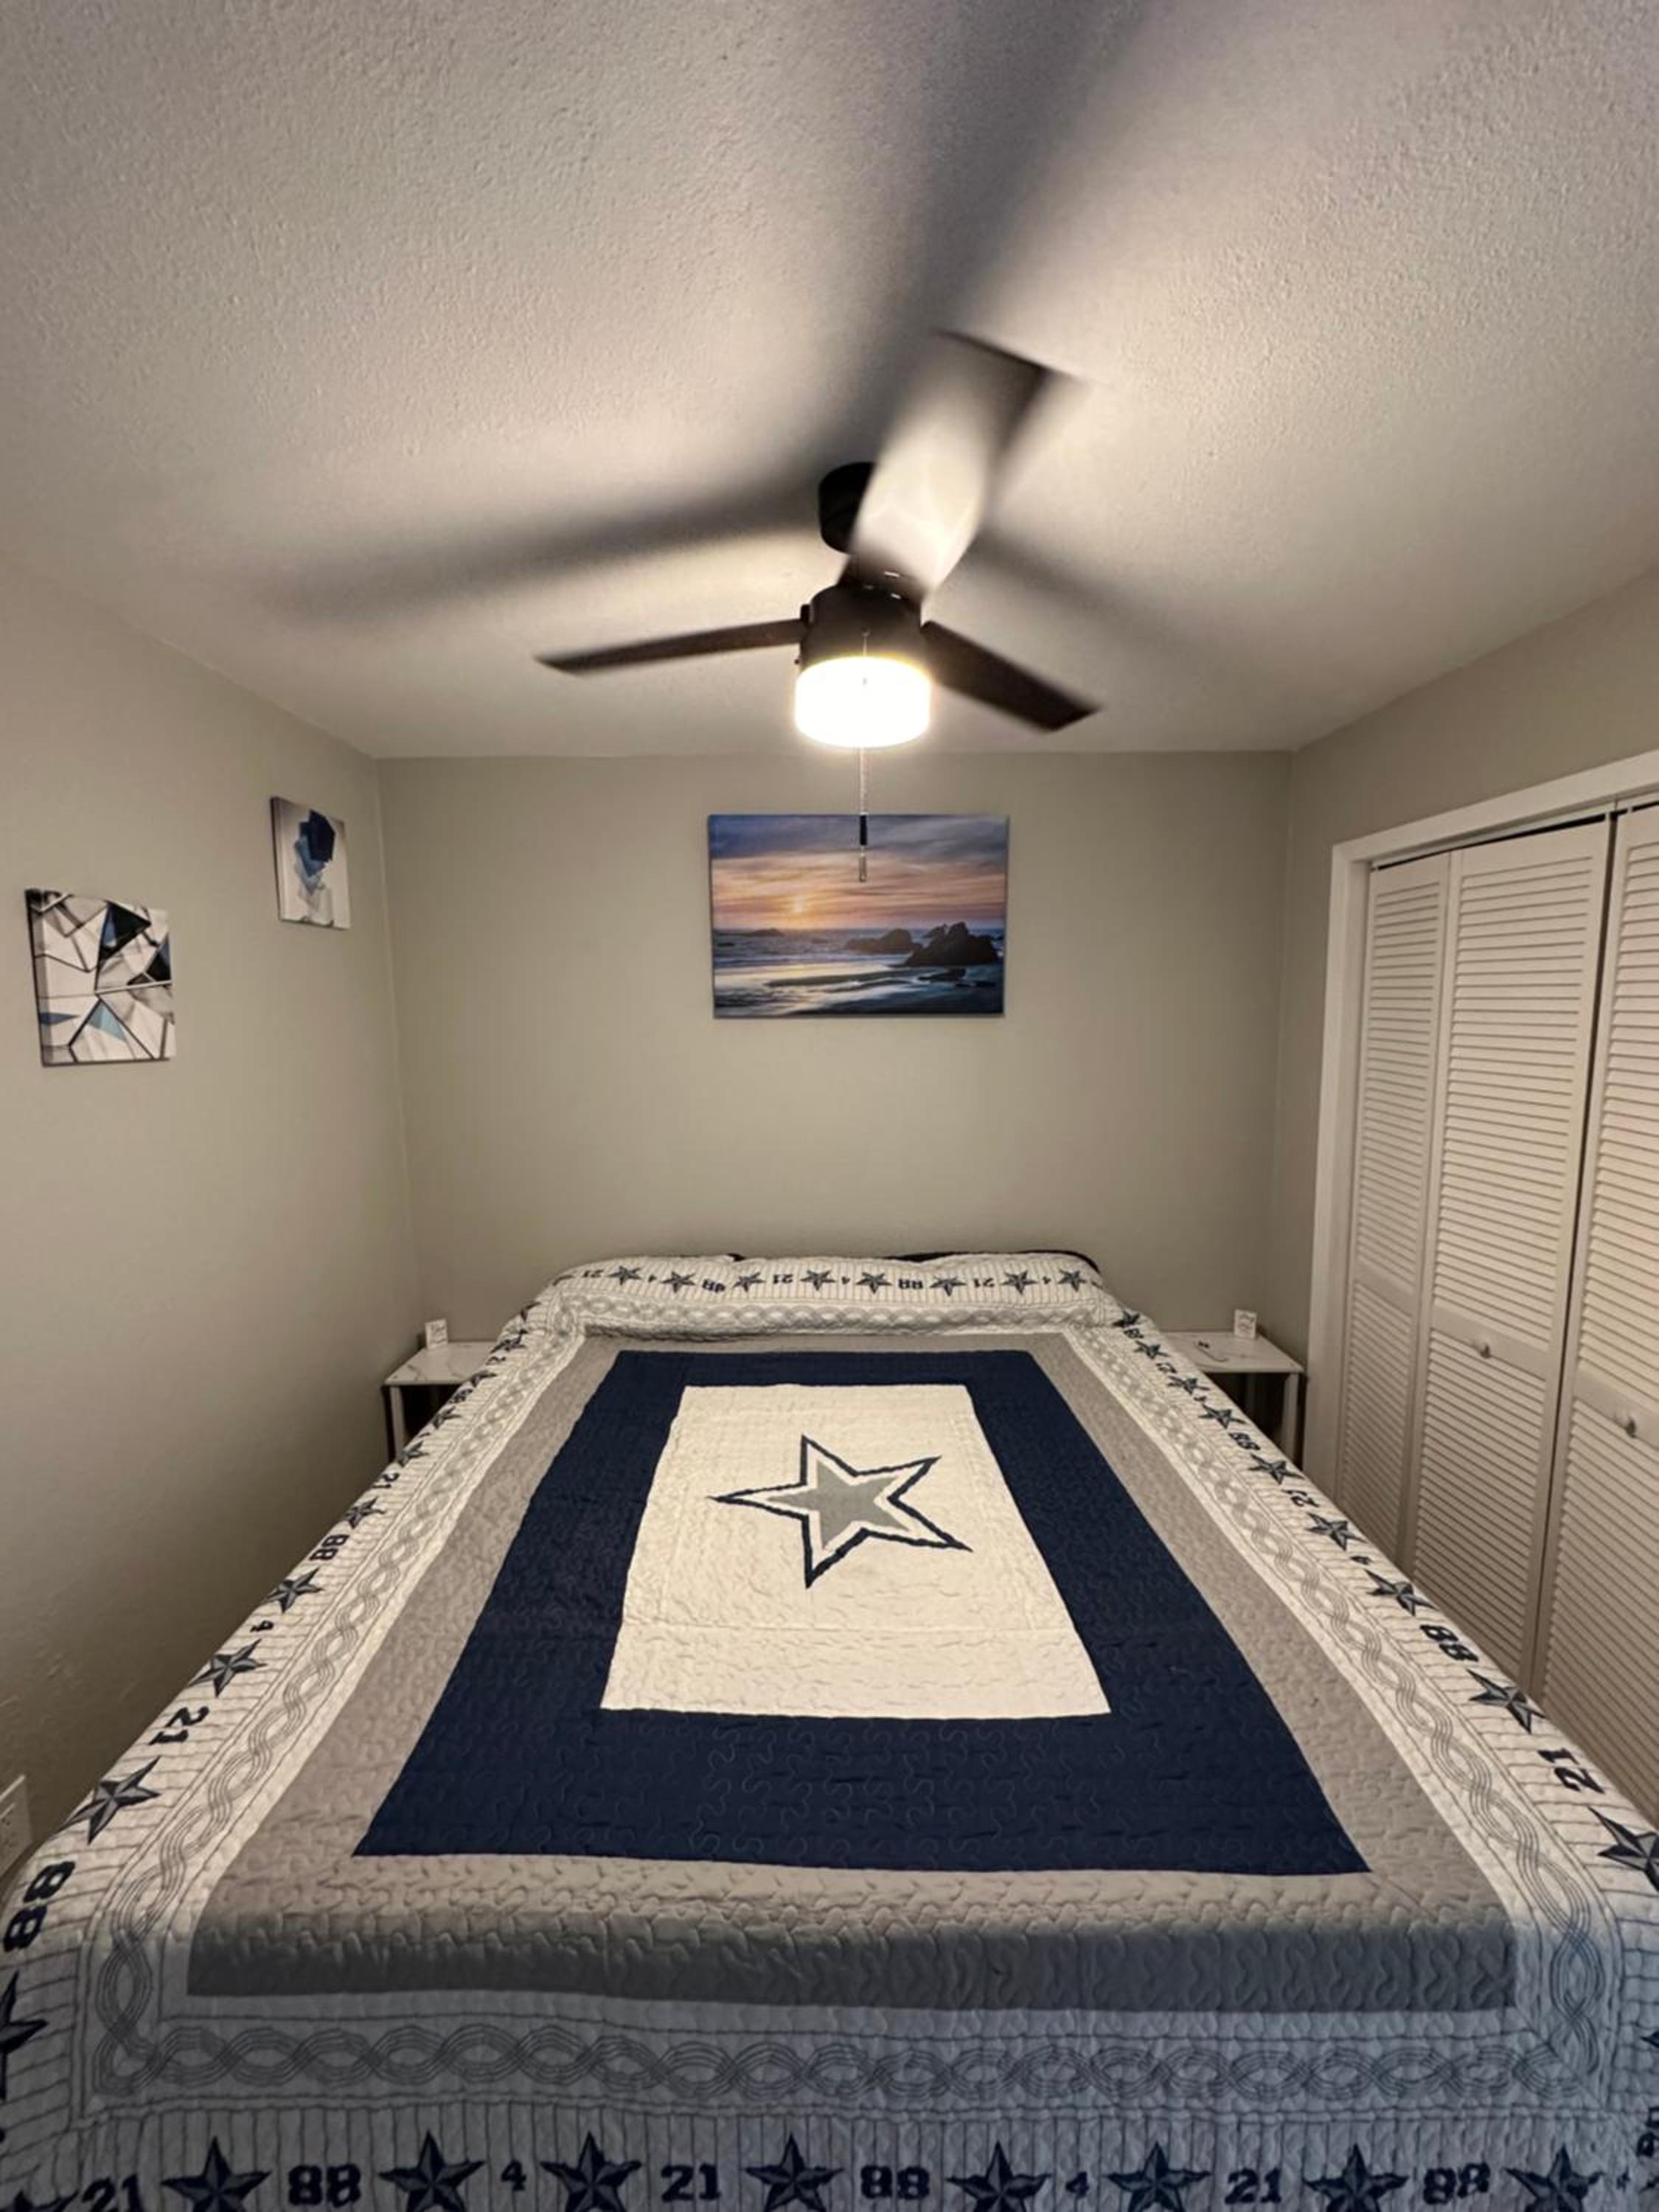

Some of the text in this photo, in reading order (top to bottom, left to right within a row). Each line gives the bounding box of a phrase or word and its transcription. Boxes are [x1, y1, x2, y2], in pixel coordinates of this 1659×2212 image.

[771, 1273, 794, 1284] 21
[308, 1534, 350, 1562] 88
[1419, 1624, 1479, 1662] 88
[148, 1705, 210, 1746] 21
[1537, 1747, 1606, 1795] 21
[3, 1860, 76, 1953] 88
[80, 2158, 1492, 2212] 21 88 4 21 88 4 21 88
